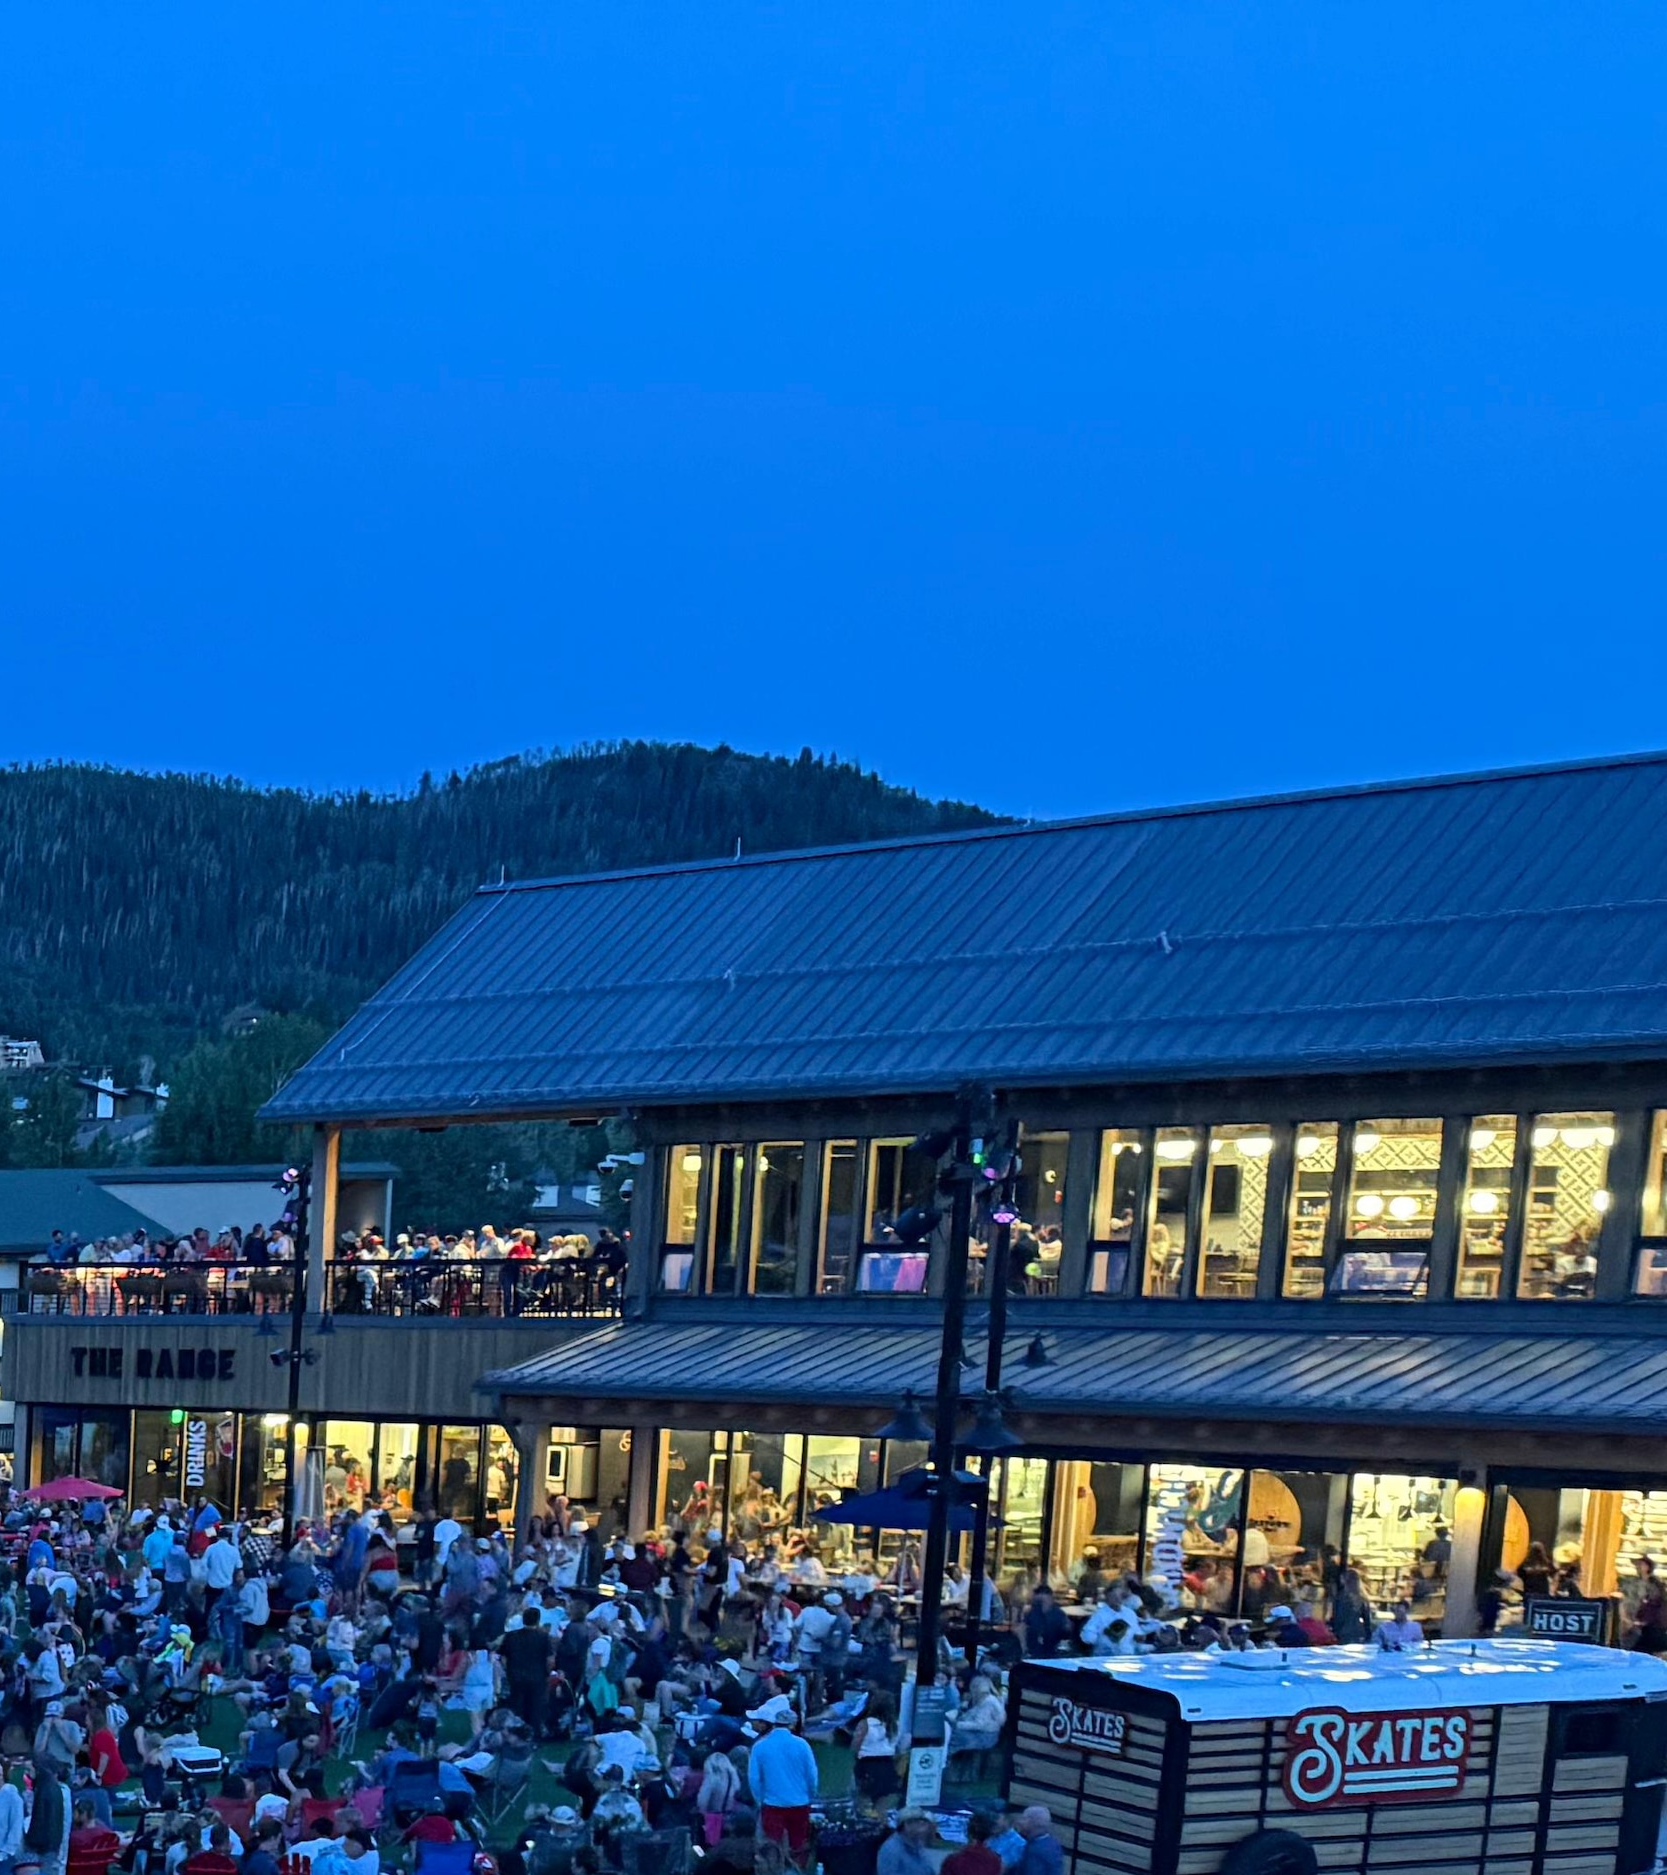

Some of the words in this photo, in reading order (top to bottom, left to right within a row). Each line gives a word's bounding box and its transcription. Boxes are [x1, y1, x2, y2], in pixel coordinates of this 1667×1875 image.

[70, 1346, 123, 1379] THE
[136, 1347, 237, 1381] RANGE
[186, 1420, 208, 1487] DRINKS
[1533, 1612, 1595, 1633] HOST
[1049, 1697, 1125, 1745] SKATES
[1289, 1713, 1466, 1803] SKATES
